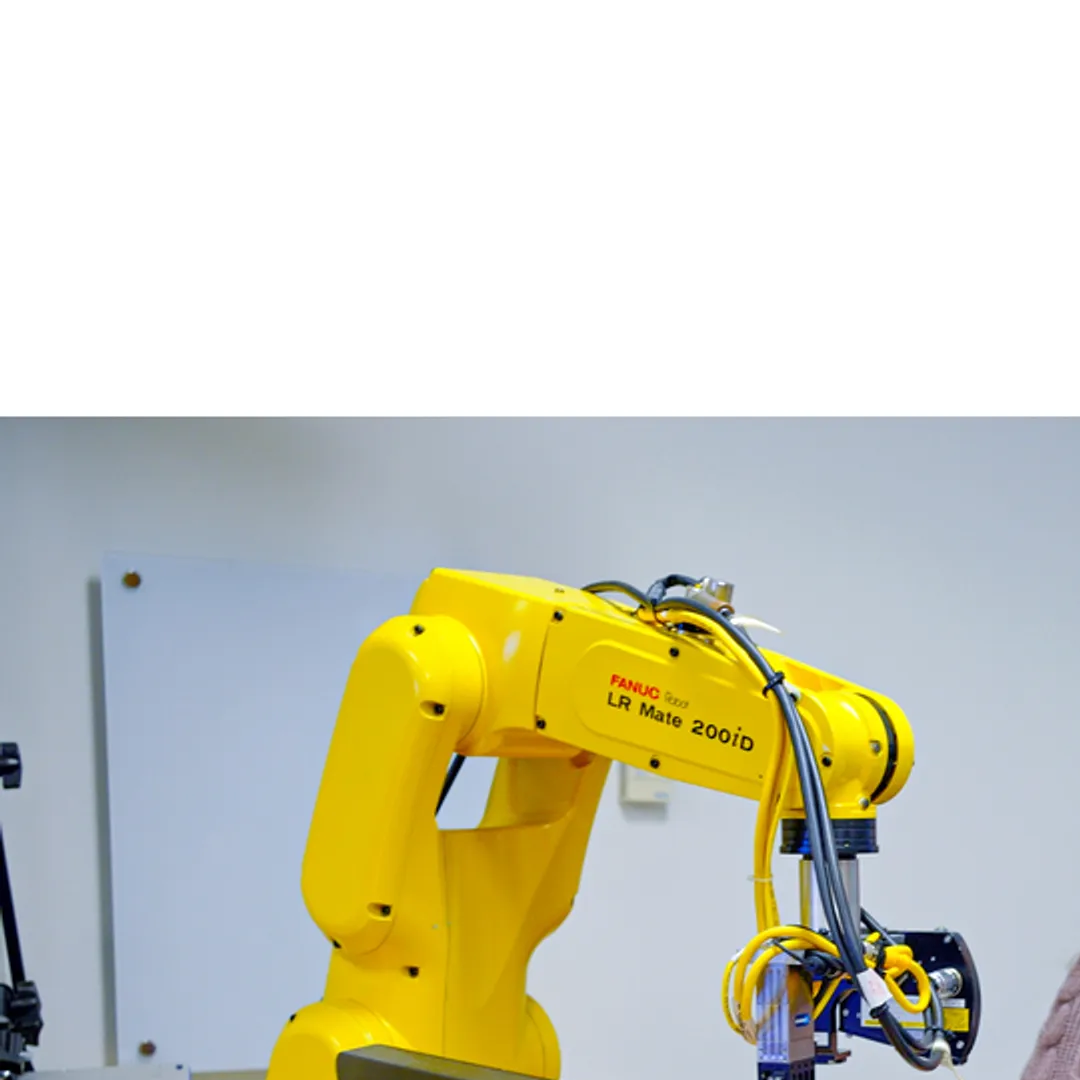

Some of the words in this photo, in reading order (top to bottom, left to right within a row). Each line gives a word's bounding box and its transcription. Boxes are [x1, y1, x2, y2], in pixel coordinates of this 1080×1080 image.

[610, 673, 660, 700] FANUC
[607, 691, 632, 711] LR
[639, 702, 683, 728] Mate
[691, 719, 755, 752] 200iD
